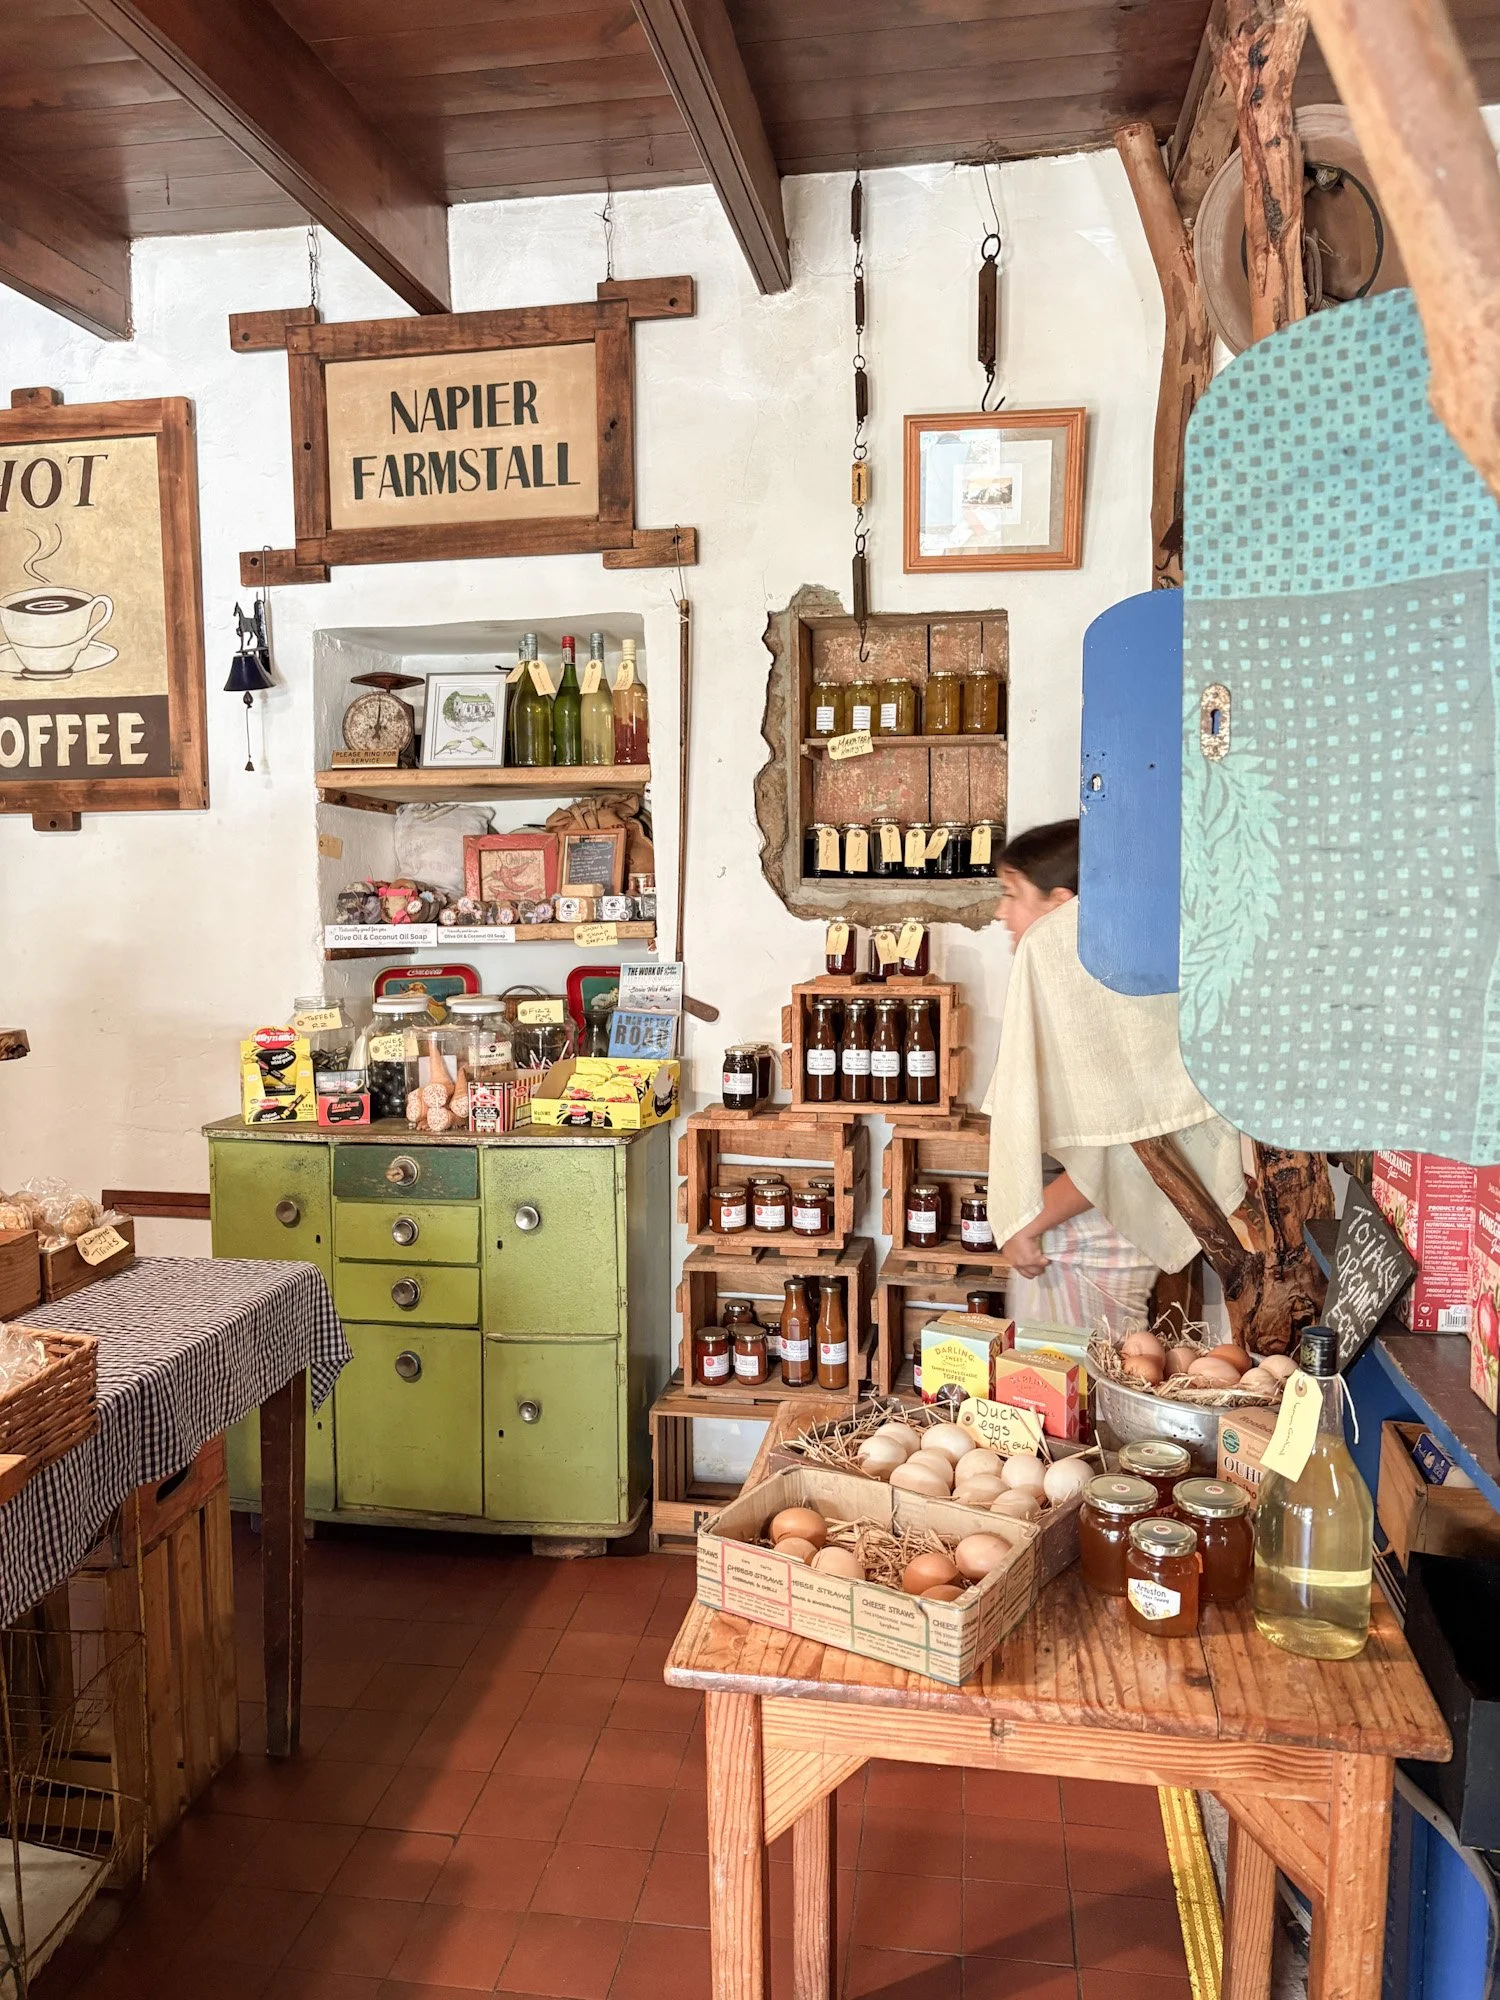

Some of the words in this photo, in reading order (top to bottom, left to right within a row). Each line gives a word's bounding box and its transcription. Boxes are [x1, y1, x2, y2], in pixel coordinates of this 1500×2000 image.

[391, 380, 539, 435] NAPIER
[352, 442, 581, 500] FARMSTALL
[369, 933, 398, 941] Coconut
[410, 933, 428, 941] Soap
[628, 967, 639, 976] THE
[639, 966, 656, 976] WORK
[656, 966, 665, 976] OF
[1417, 1318, 1424, 1327] 2
[1425, 1319, 1432, 1328] L
[935, 1346, 975, 1362] DARLING
[943, 1373, 966, 1383] TOFFEE
[976, 1398, 1019, 1421] Duck
[978, 1420, 1010, 1441] eggs
[727, 1564, 754, 1579] CHEESE
[754, 1571, 784, 1586] STRAWS
[816, 1586, 851, 1601] STRAWS
[861, 1598, 887, 1613] CHEESE
[888, 1605, 916, 1620] STRAWS
[932, 1619, 958, 1632] CHEESE
